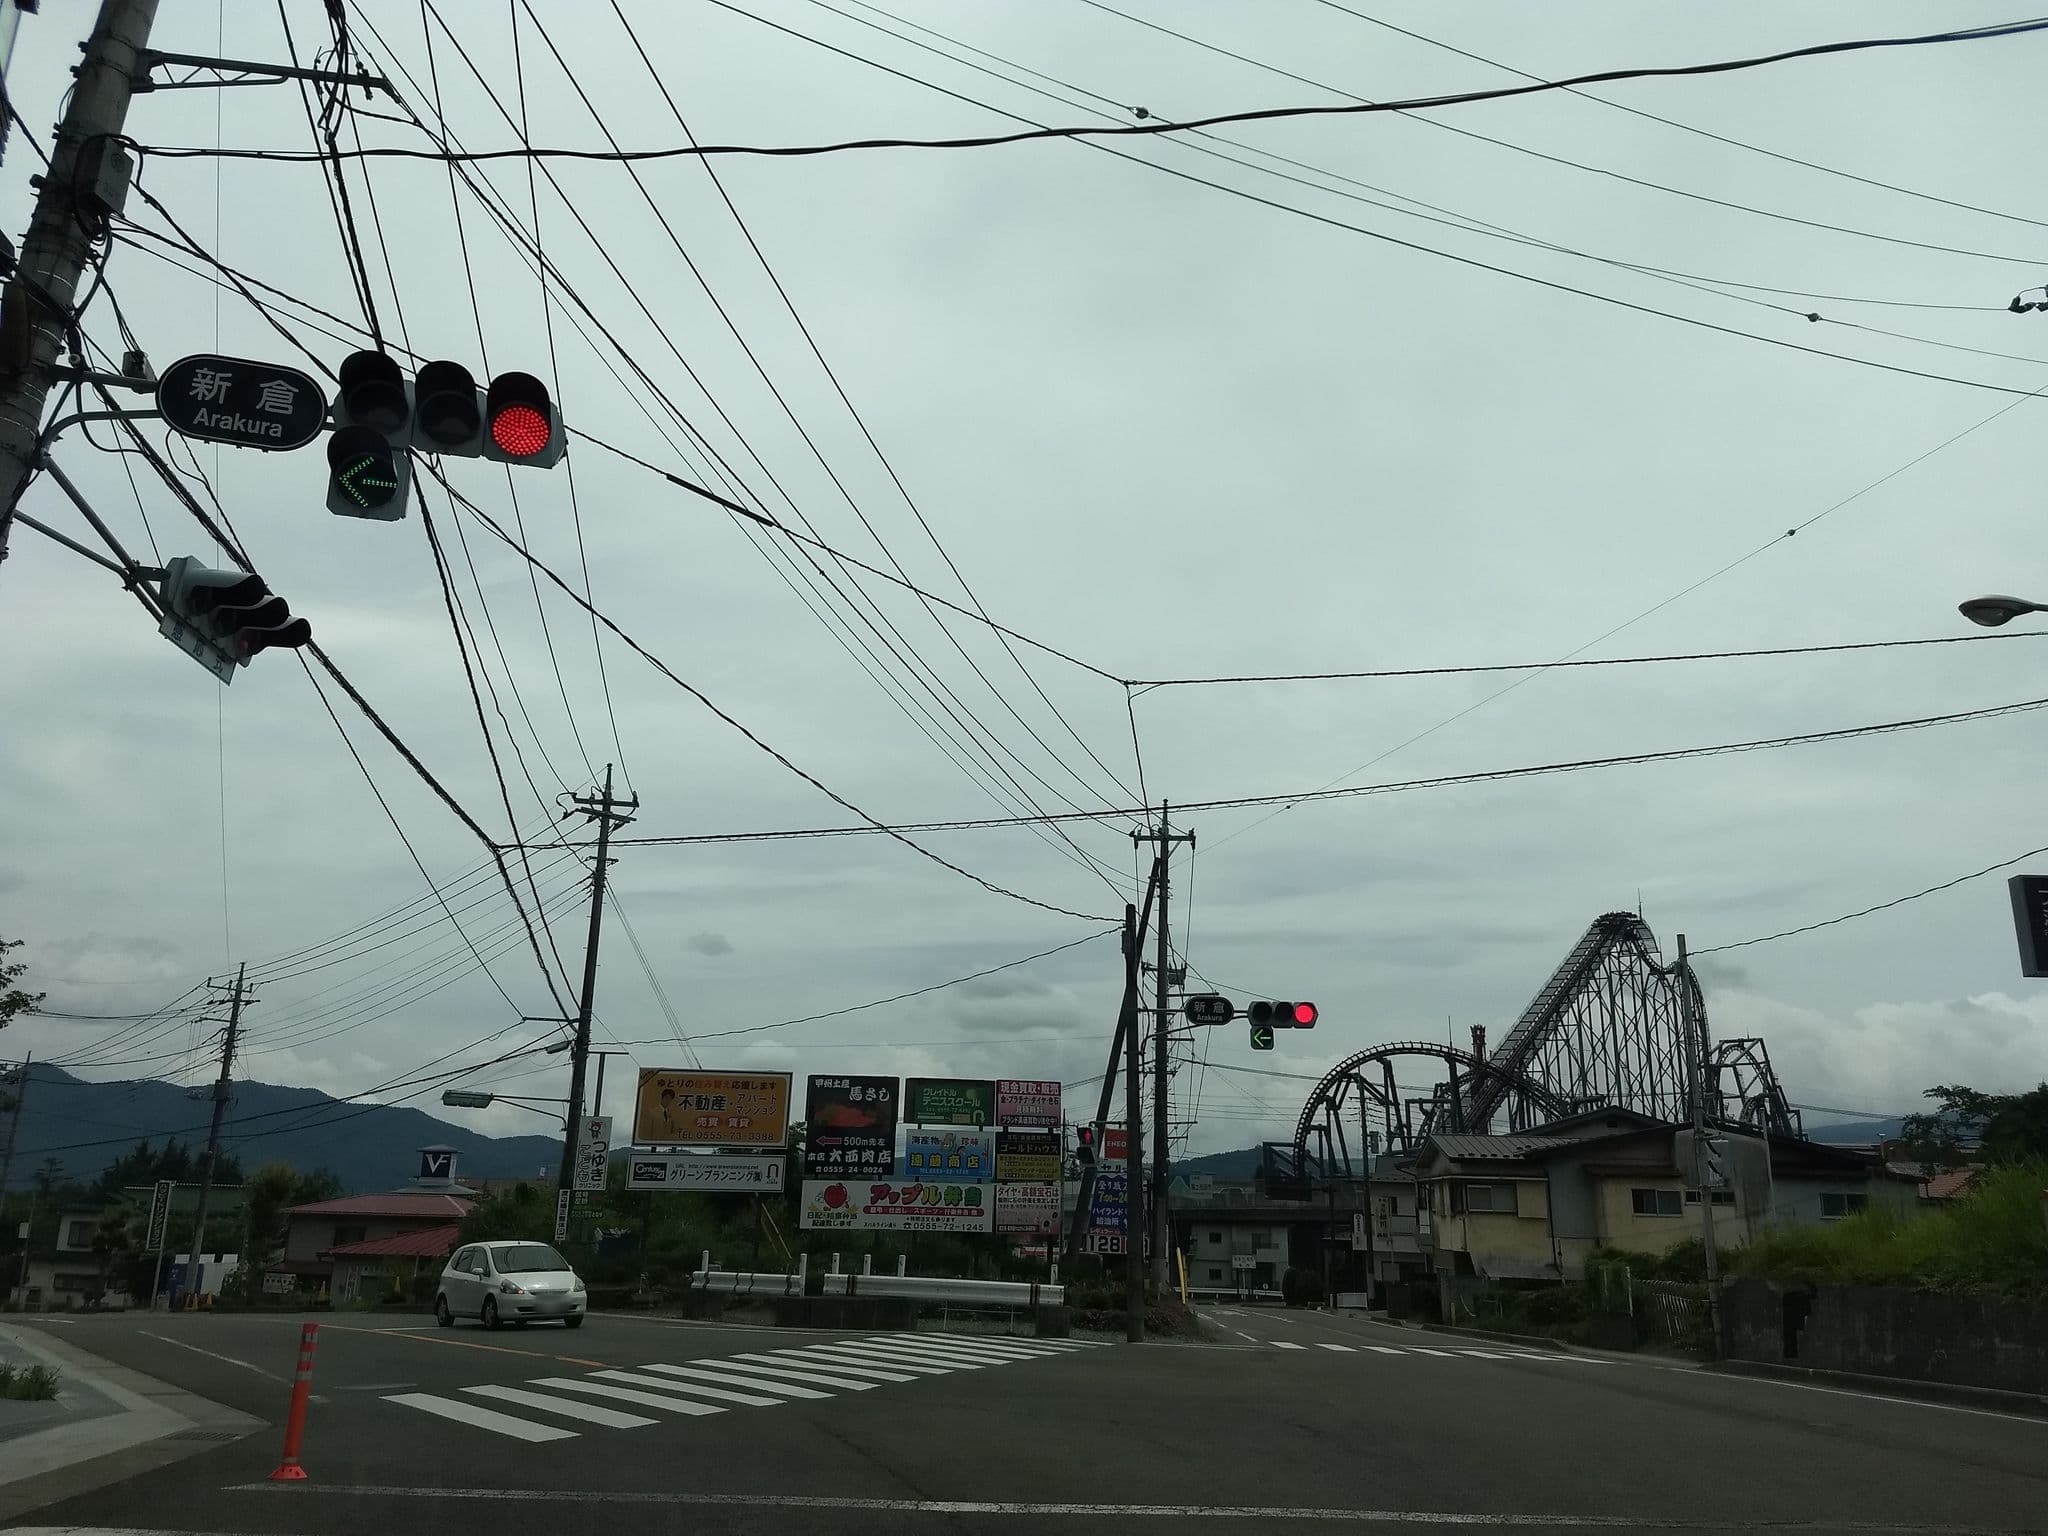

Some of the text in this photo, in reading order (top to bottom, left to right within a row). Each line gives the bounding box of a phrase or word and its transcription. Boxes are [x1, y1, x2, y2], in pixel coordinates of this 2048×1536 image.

[189, 367, 300, 415] 新倉
[193, 407, 283, 438] Arakura
[1194, 1001, 1225, 1014] 新倉
[1197, 1014, 1223, 1022] Arakura
[849, 1086, 890, 1102] 馬さし
[922, 1087, 957, 1098] クレイドル
[737, 1094, 777, 1105] アパート
[922, 1096, 981, 1107] テニススクール
[736, 1105, 777, 1117] マンション
[697, 1117, 720, 1128] 売買
[677, 1130, 693, 1140] TEL
[1000, 1143, 1058, 1154] ゴールドハウス
[589, 1141, 607, 1182] つゆき
[870, 1183, 983, 1207] アップル弁当
[1092, 1207, 1124, 1217] ハイランド
[913, 1222, 984, 1232] 0555-72-1245
[1096, 1217, 1120, 1226] 給油所
[1090, 1235, 1121, 1253] 128
